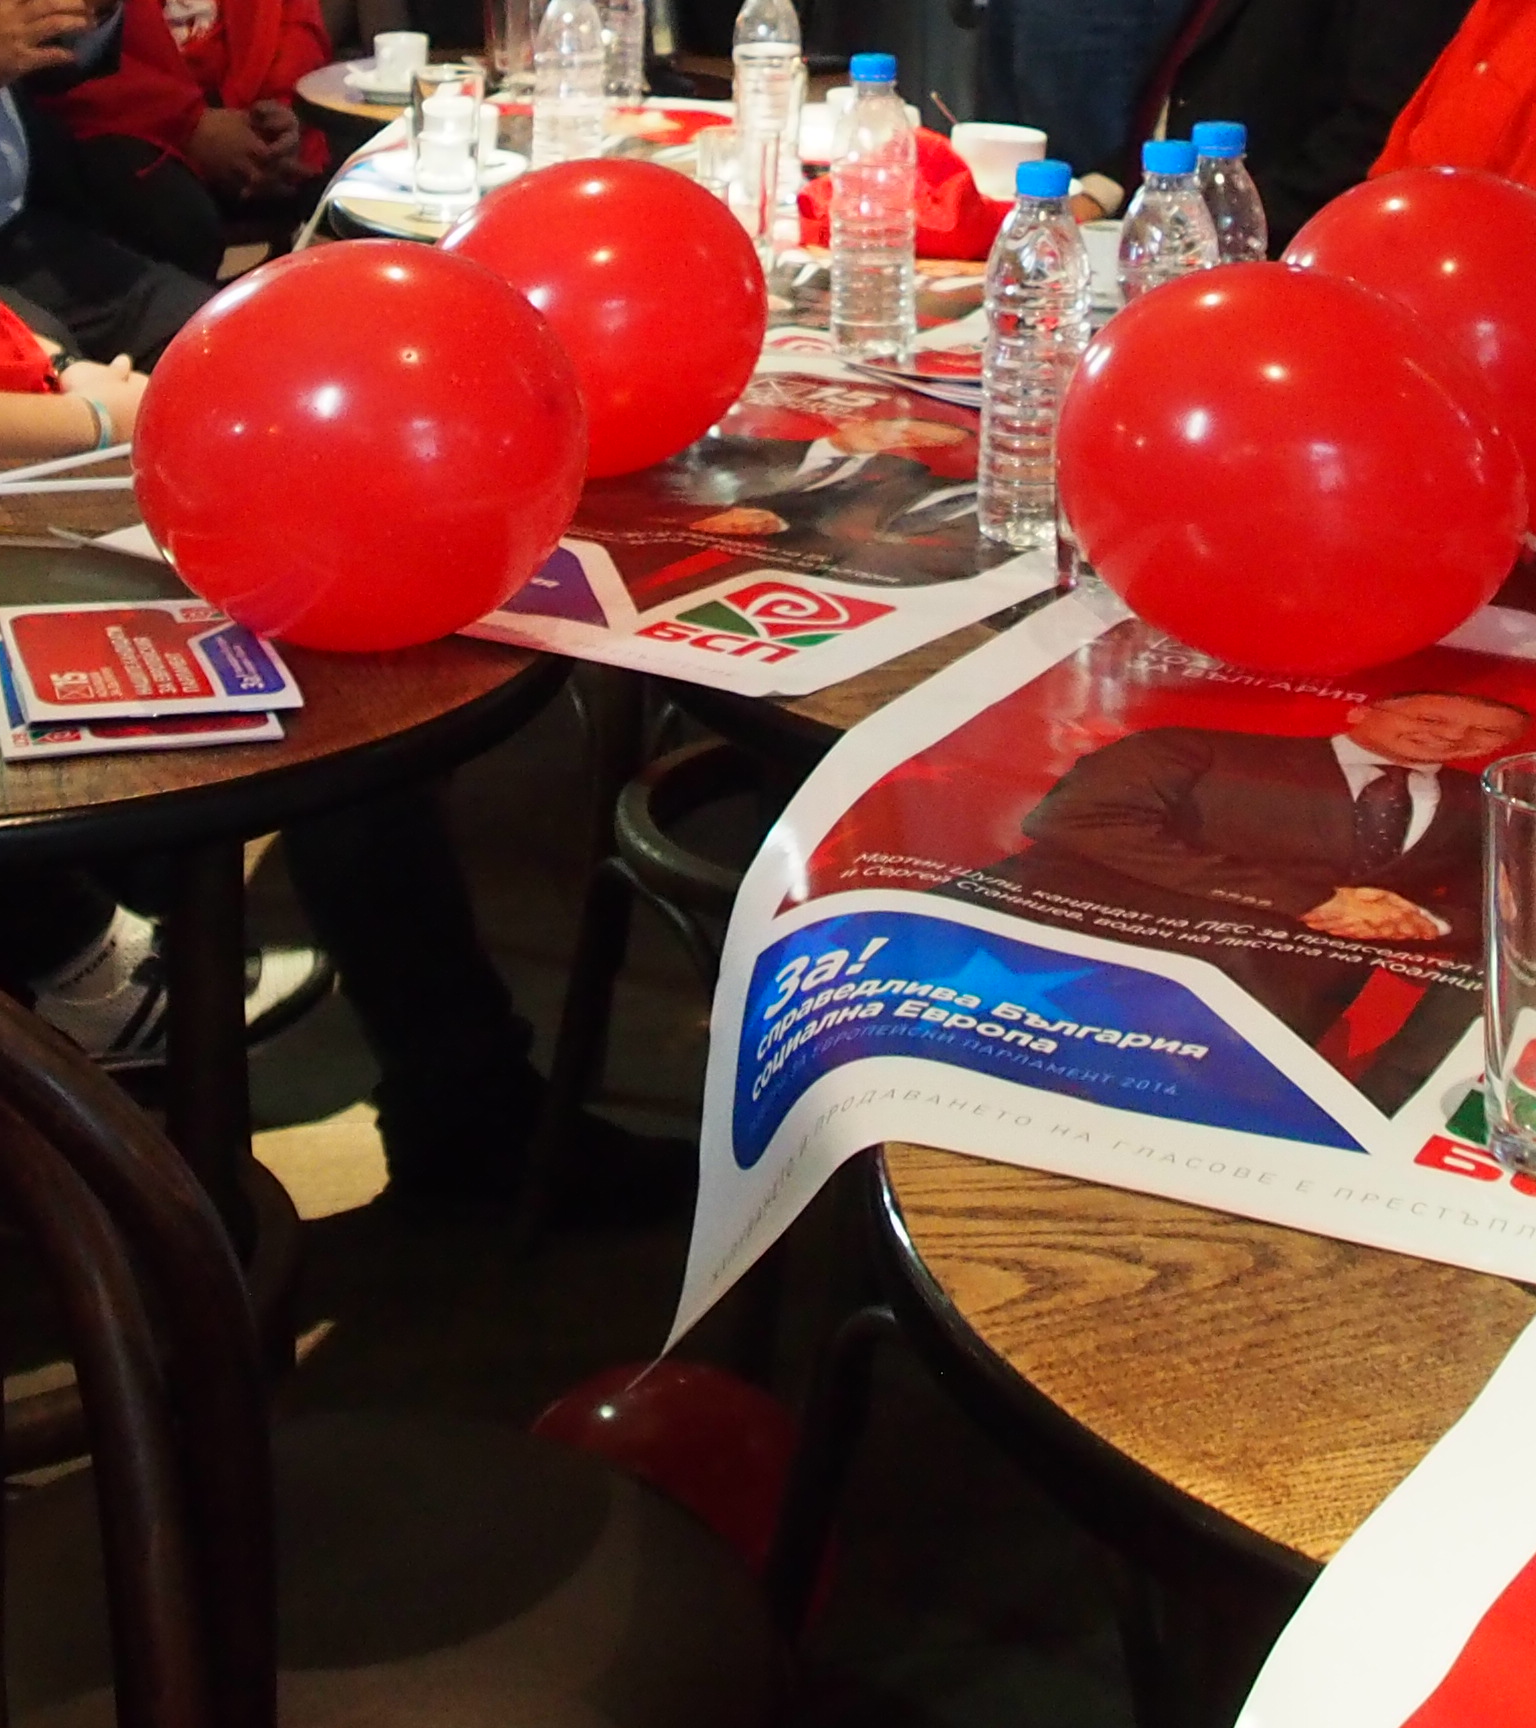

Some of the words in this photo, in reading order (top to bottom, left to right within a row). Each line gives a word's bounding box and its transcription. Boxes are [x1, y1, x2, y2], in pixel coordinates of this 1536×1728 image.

[633, 620, 800, 664] БСП
[854, 852, 947, 871] Мартин
[1032, 889, 1155, 921] кандидат
[1155, 915, 1190, 929] на
[1197, 919, 1250, 936] ПЕС
[1292, 933, 1474, 973] председател
[1177, 931, 1212, 945] на
[1328, 950, 1364, 964] на
[756, 976, 983, 1062] справедлива
[990, 1000, 1212, 1060] България
[763, 936, 890, 1022] За!
[751, 1000, 885, 1102] социална
[893, 998, 1060, 1056] Европа
[963, 1035, 1118, 1086] ПАРЛАМЕНТ
[1119, 1074, 1181, 1098] 2014
[814, 1086, 1035, 1140] ПРОДАВАНЕТО
[1050, 1123, 1093, 1142] НА
[1111, 1138, 1277, 1186] ГЛАСОВЕ
[1295, 1177, 1312, 1194] Е
